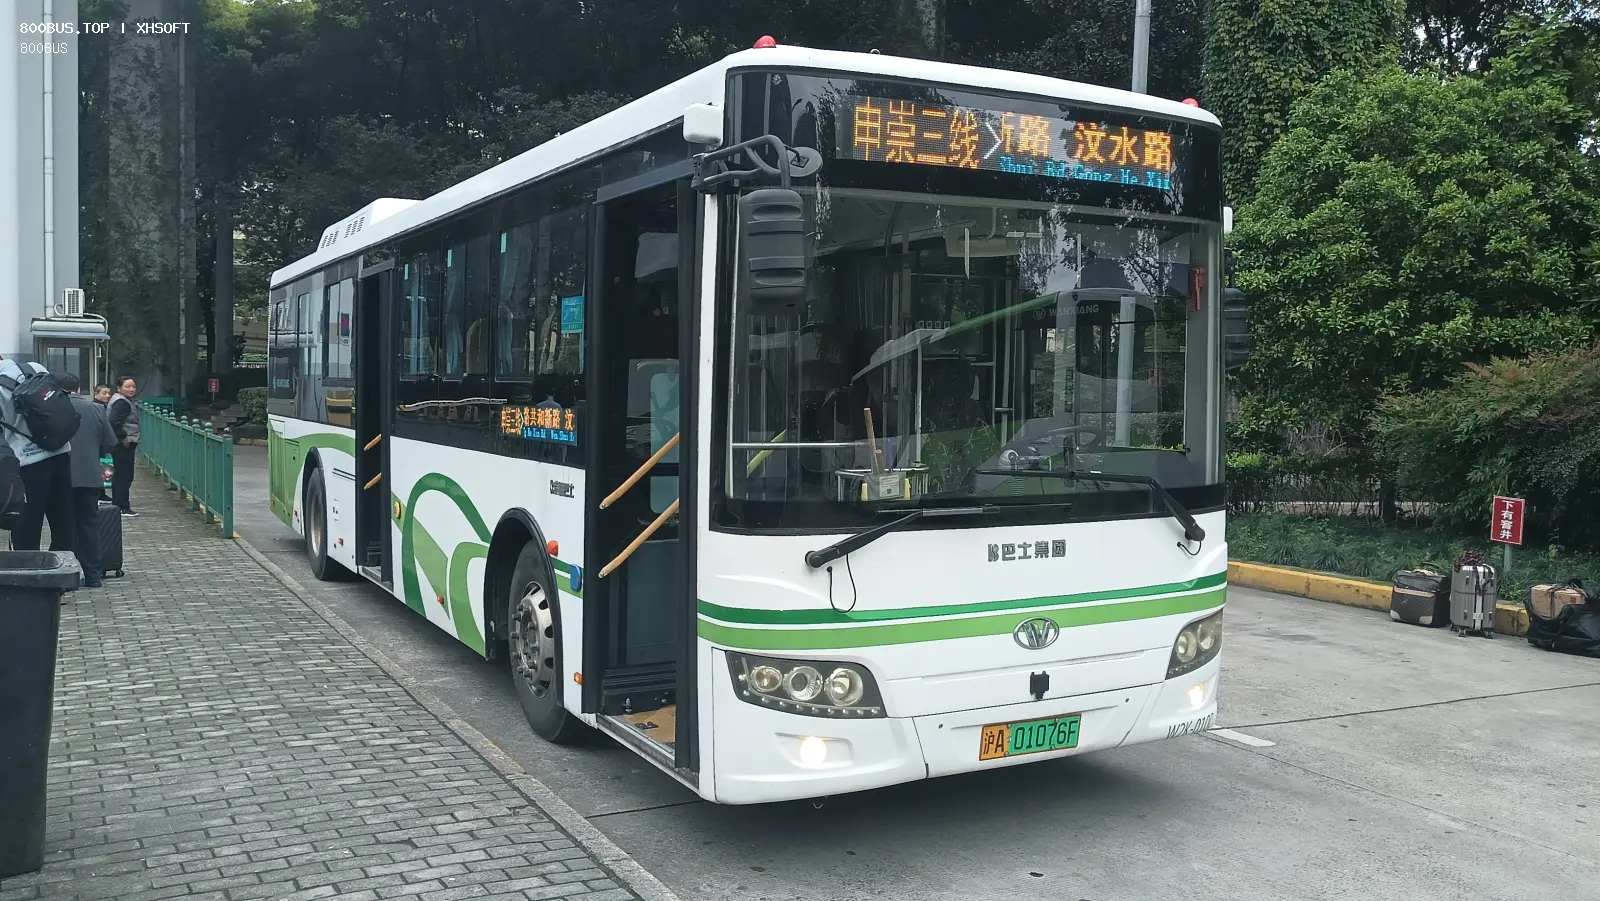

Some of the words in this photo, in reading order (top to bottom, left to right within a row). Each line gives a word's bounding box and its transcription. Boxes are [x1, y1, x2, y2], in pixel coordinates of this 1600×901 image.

[1074, 121, 1173, 172] 汶水路
[1046, 160, 1067, 178] Rd
[1119, 168, 1139, 185] He
[1049, 304, 1100, 317] WANXIANG
